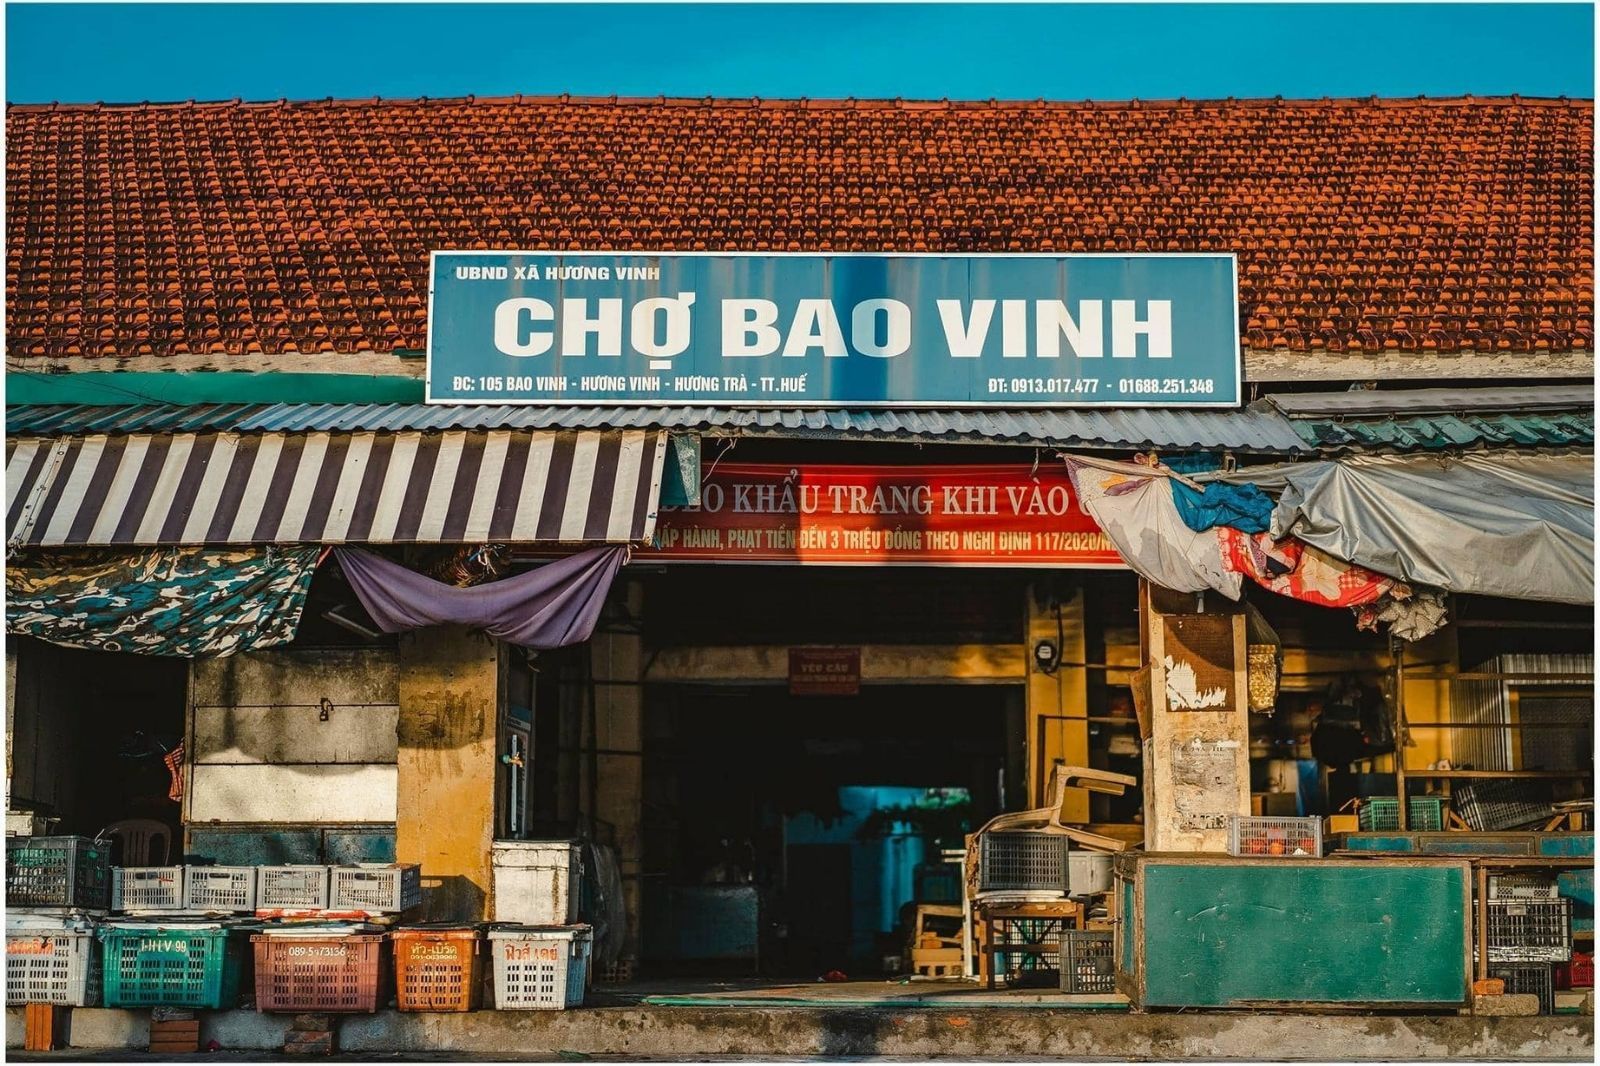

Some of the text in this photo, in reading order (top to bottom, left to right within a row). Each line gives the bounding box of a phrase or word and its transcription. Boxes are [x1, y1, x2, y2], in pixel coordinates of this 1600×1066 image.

[456, 264, 660, 281] UBND XÃ HƯƠNG VINH
[494, 291, 1173, 370] CHỢ BAO VINH
[453, 376, 476, 391] ĐC:
[480, 377, 503, 391] 105
[506, 377, 533, 391] BAO
[536, 377, 567, 391] VINH
[580, 375, 626, 392] HƯƠNG
[629, 376, 661, 392] VINH
[674, 376, 720, 392] HƯƠNG
[722, 373, 748, 392] TRÀ
[760, 373, 808, 392] TT.HUẾ
[988, 378, 1008, 393] ĐT:
[1011, 378, 1099, 394] 0913.017.477
[1119, 378, 1214, 394] 01688.251.348
[732, 468, 818, 515] KHẨU
[828, 485, 934, 516] TRANG
[941, 486, 999, 516] KHI
[1004, 477, 1070, 516] VÀO
[683, 525, 724, 551] HÀNH,
[727, 528, 763, 553] PHẠT
[800, 524, 827, 550] ĐẾN
[830, 531, 839, 550] 3
[843, 526, 881, 554] TRIỆU
[885, 524, 922, 550] ĐỒNG
[925, 530, 959, 551] THEO
[963, 530, 995, 555] NGHỊ
[998, 531, 1032, 555] ĐỊNH
[1035, 532, 1117, 551] 117/2020/N
[175, 940, 187, 953] 99
